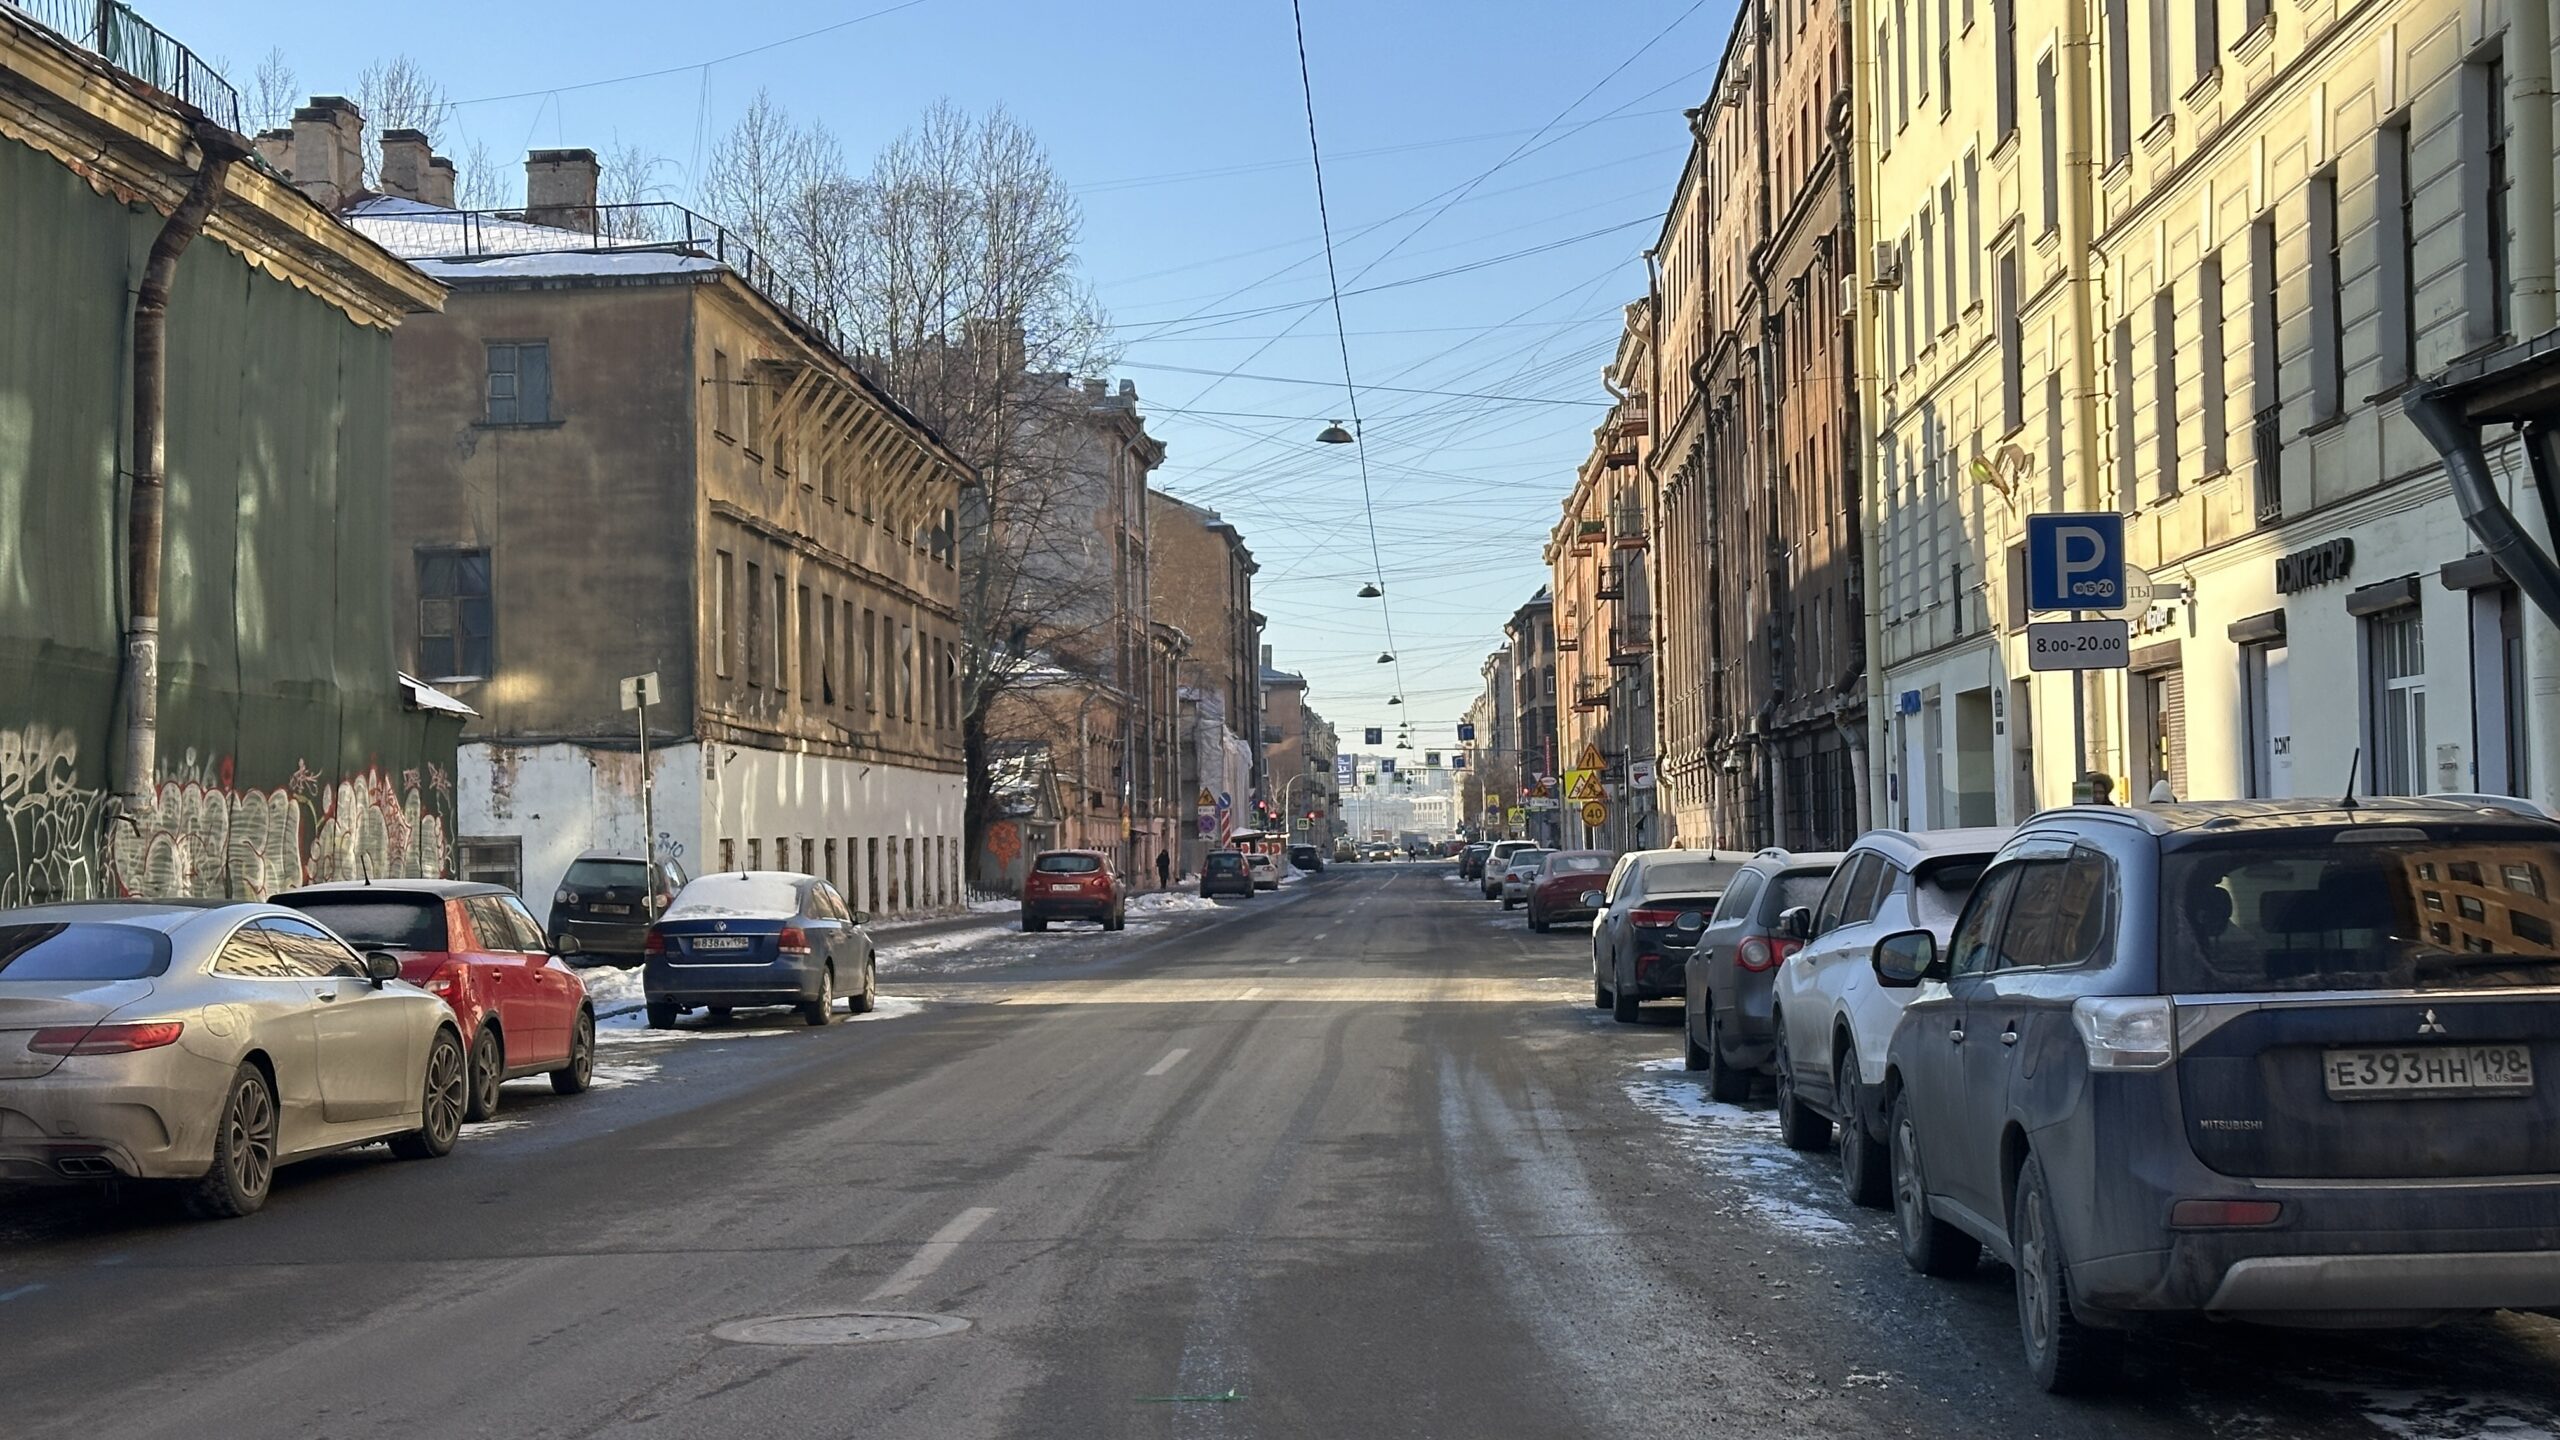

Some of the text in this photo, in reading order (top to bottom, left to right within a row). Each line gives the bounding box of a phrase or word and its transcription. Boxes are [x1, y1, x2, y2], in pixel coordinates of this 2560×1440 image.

[2055, 526, 2106, 599] P
[2086, 583, 2096, 593] 15
[2099, 582, 2113, 594] 20
[2036, 635, 2121, 653] 8.00-20.00
[1587, 808, 1602, 819] 40
[2336, 1049, 2524, 1087] E393HH 198
[2486, 1073, 2510, 1083] RUS
[2200, 1119, 2263, 1130] MITSUBISHI
